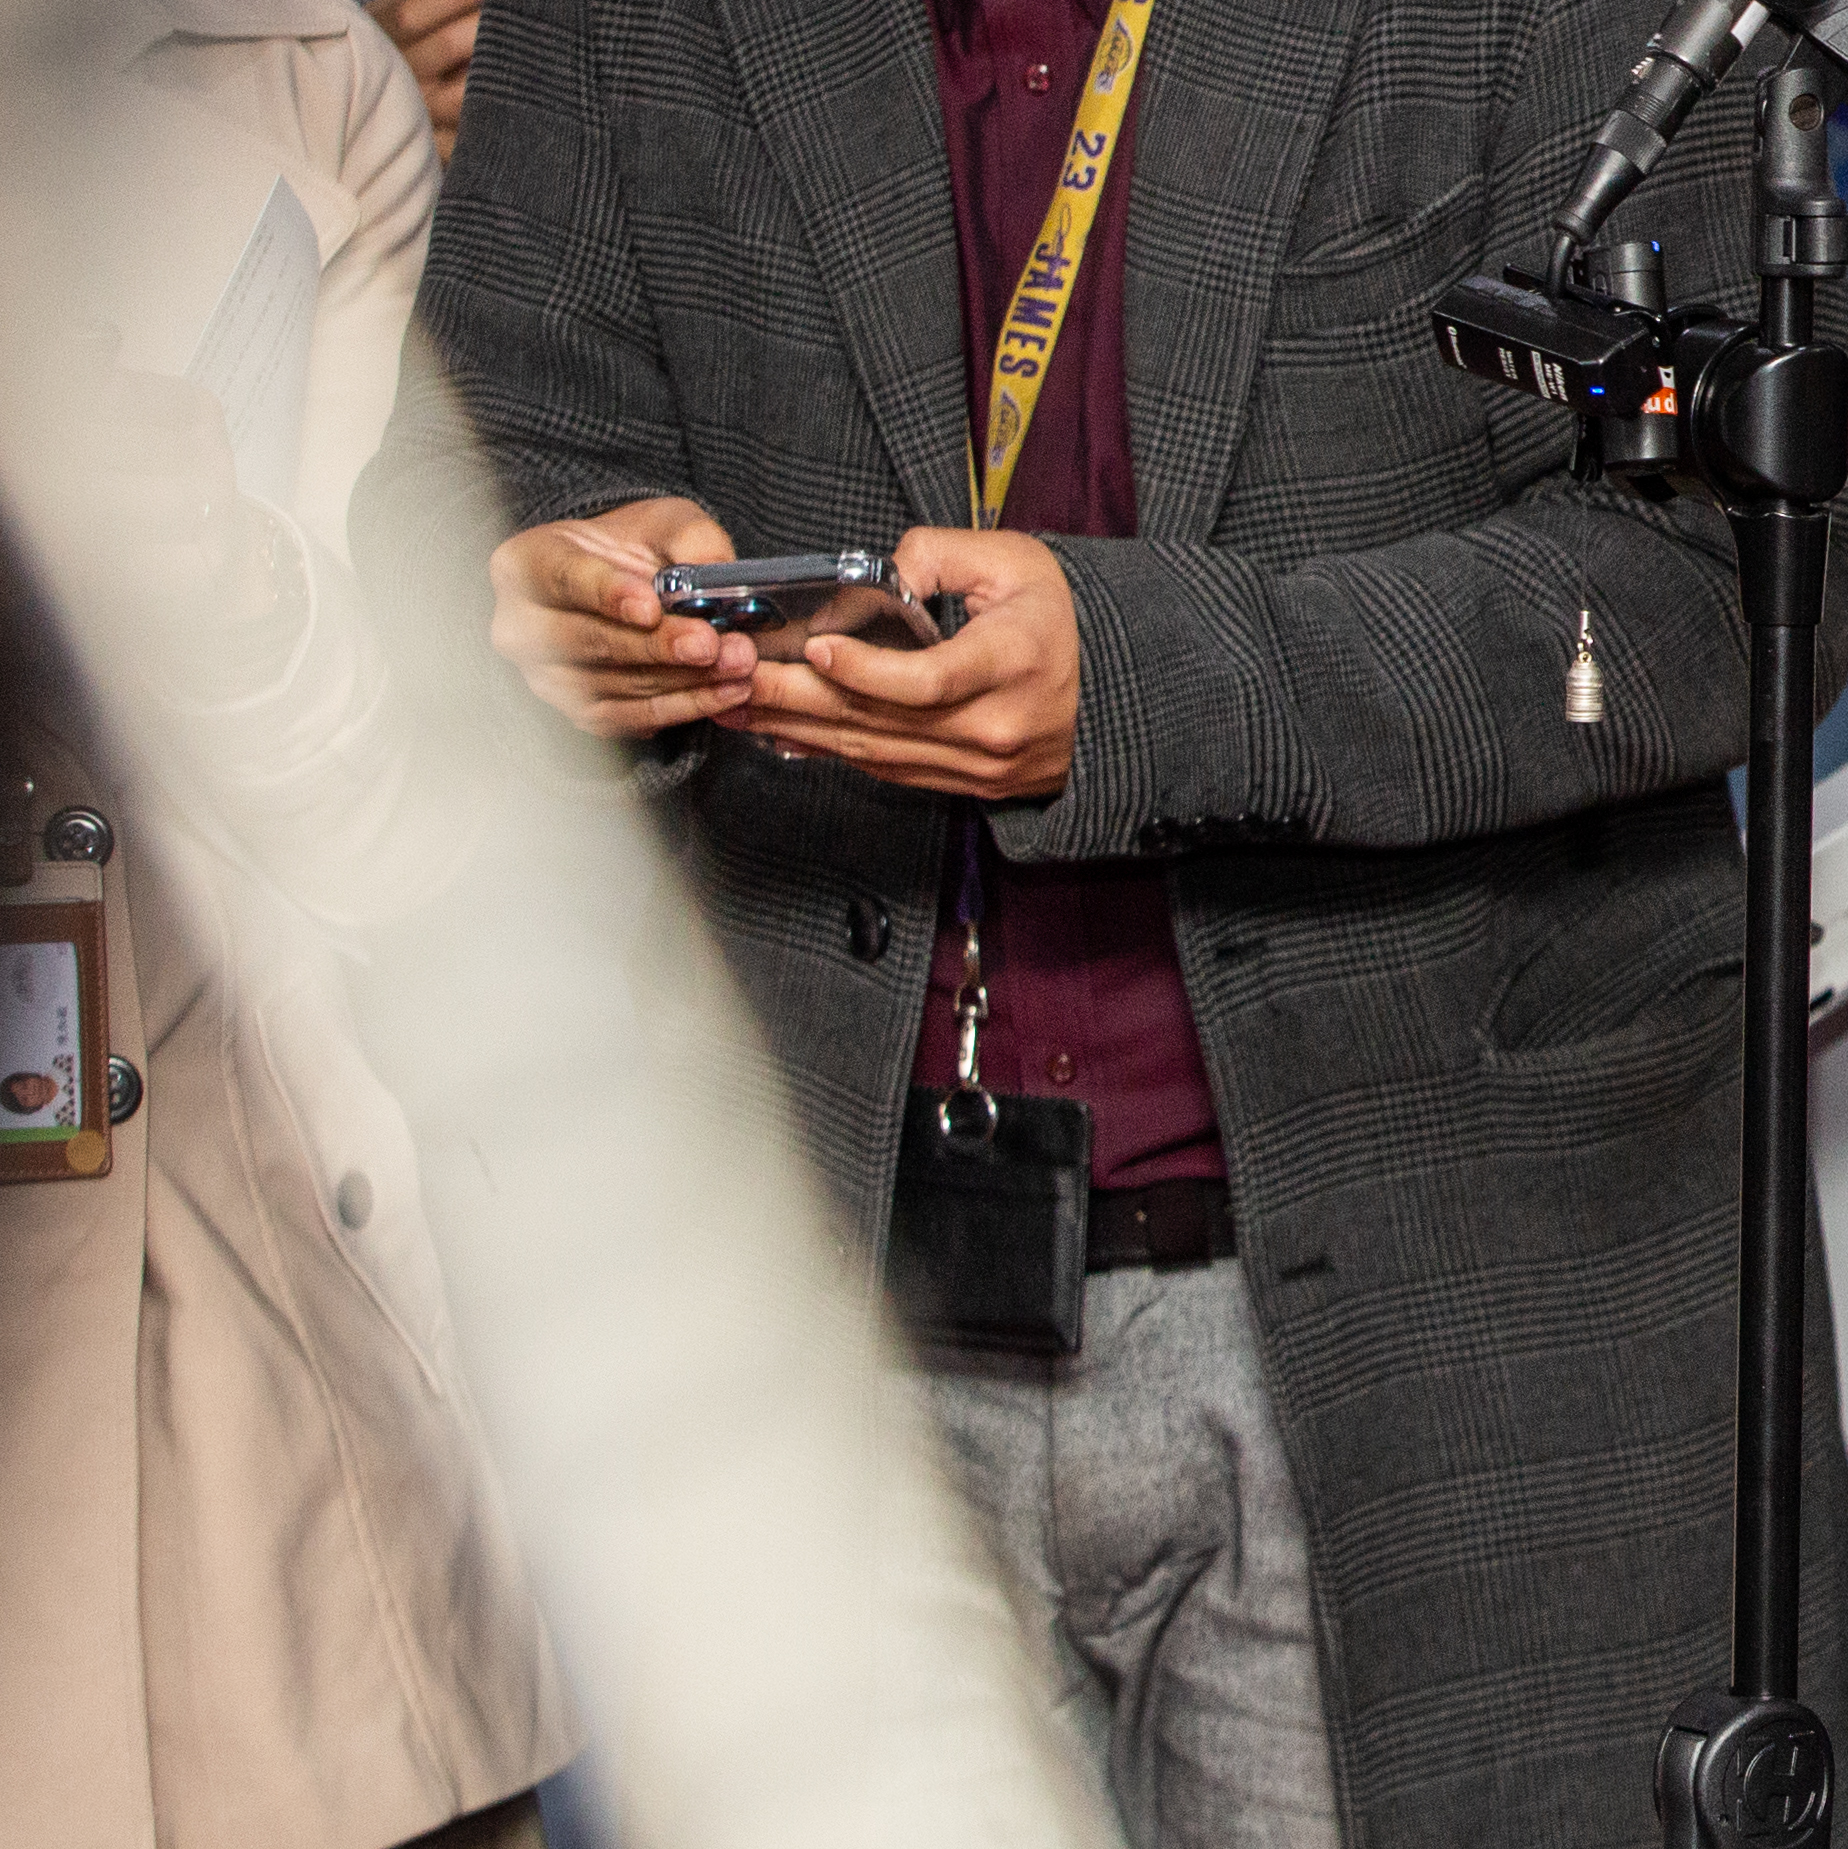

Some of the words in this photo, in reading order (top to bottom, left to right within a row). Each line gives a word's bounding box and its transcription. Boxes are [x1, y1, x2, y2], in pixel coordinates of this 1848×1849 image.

[1062, 129, 1107, 192] 23
[999, 242, 1071, 378] JAMES
[1551, 362, 1569, 402] Nikon
